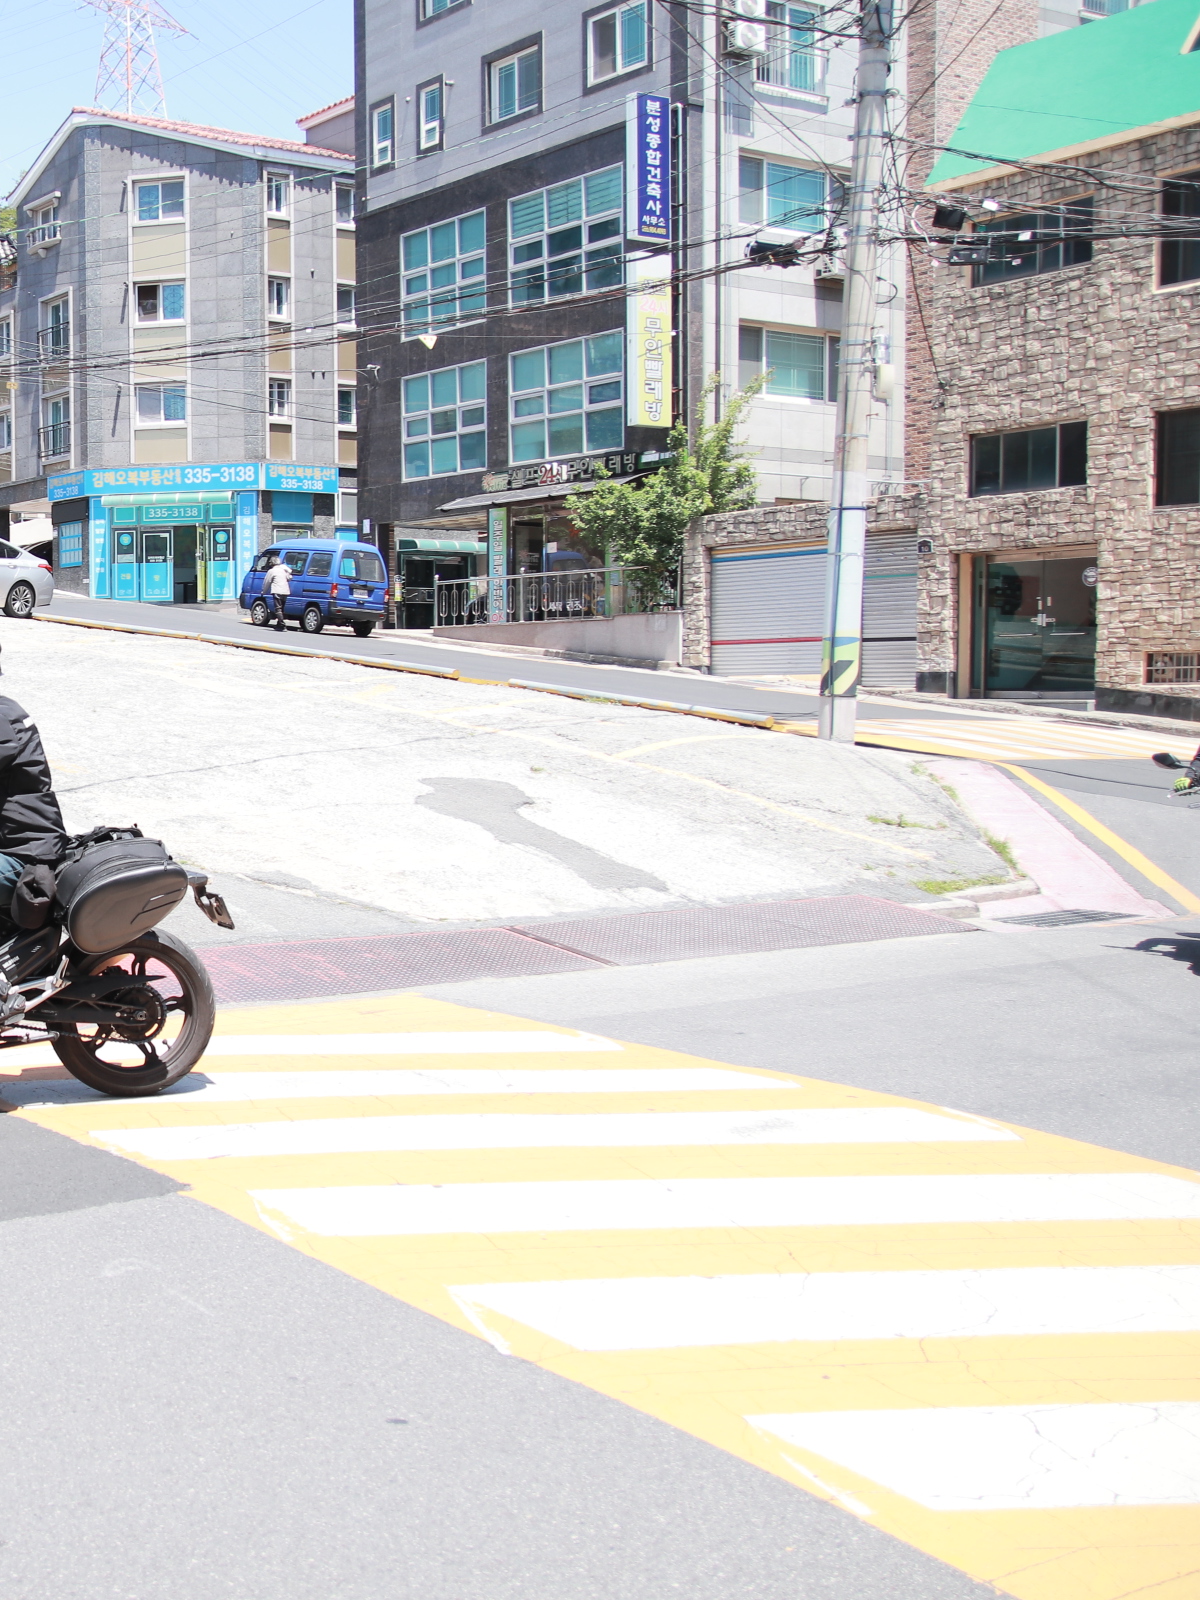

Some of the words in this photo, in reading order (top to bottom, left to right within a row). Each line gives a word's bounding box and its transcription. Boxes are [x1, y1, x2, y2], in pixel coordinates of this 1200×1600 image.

[644, 317, 663, 421] 무인빨래방
[184, 466, 255, 484] 335-3138
[280, 478, 324, 490] 335-3138
[53, 486, 79, 498] 335-3138
[148, 507, 198, 518] 335-3138
